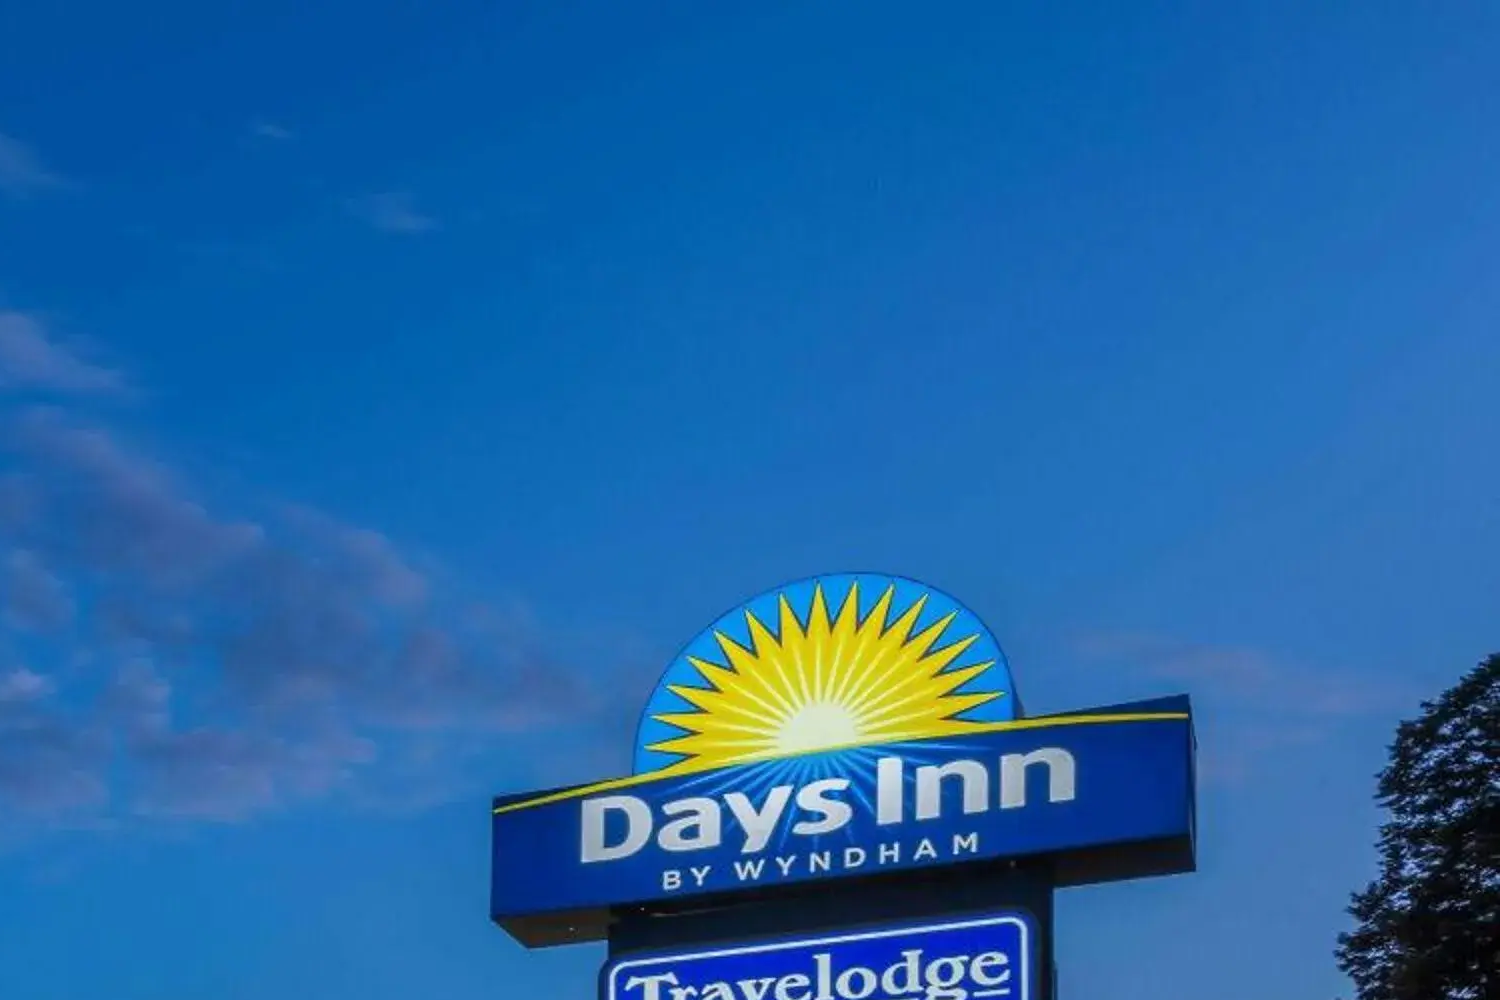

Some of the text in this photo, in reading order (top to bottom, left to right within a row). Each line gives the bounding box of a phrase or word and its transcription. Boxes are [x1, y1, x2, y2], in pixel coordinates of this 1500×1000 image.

[580, 747, 1076, 864] Days Inn
[662, 832, 979, 891] BY WYNDHAM
